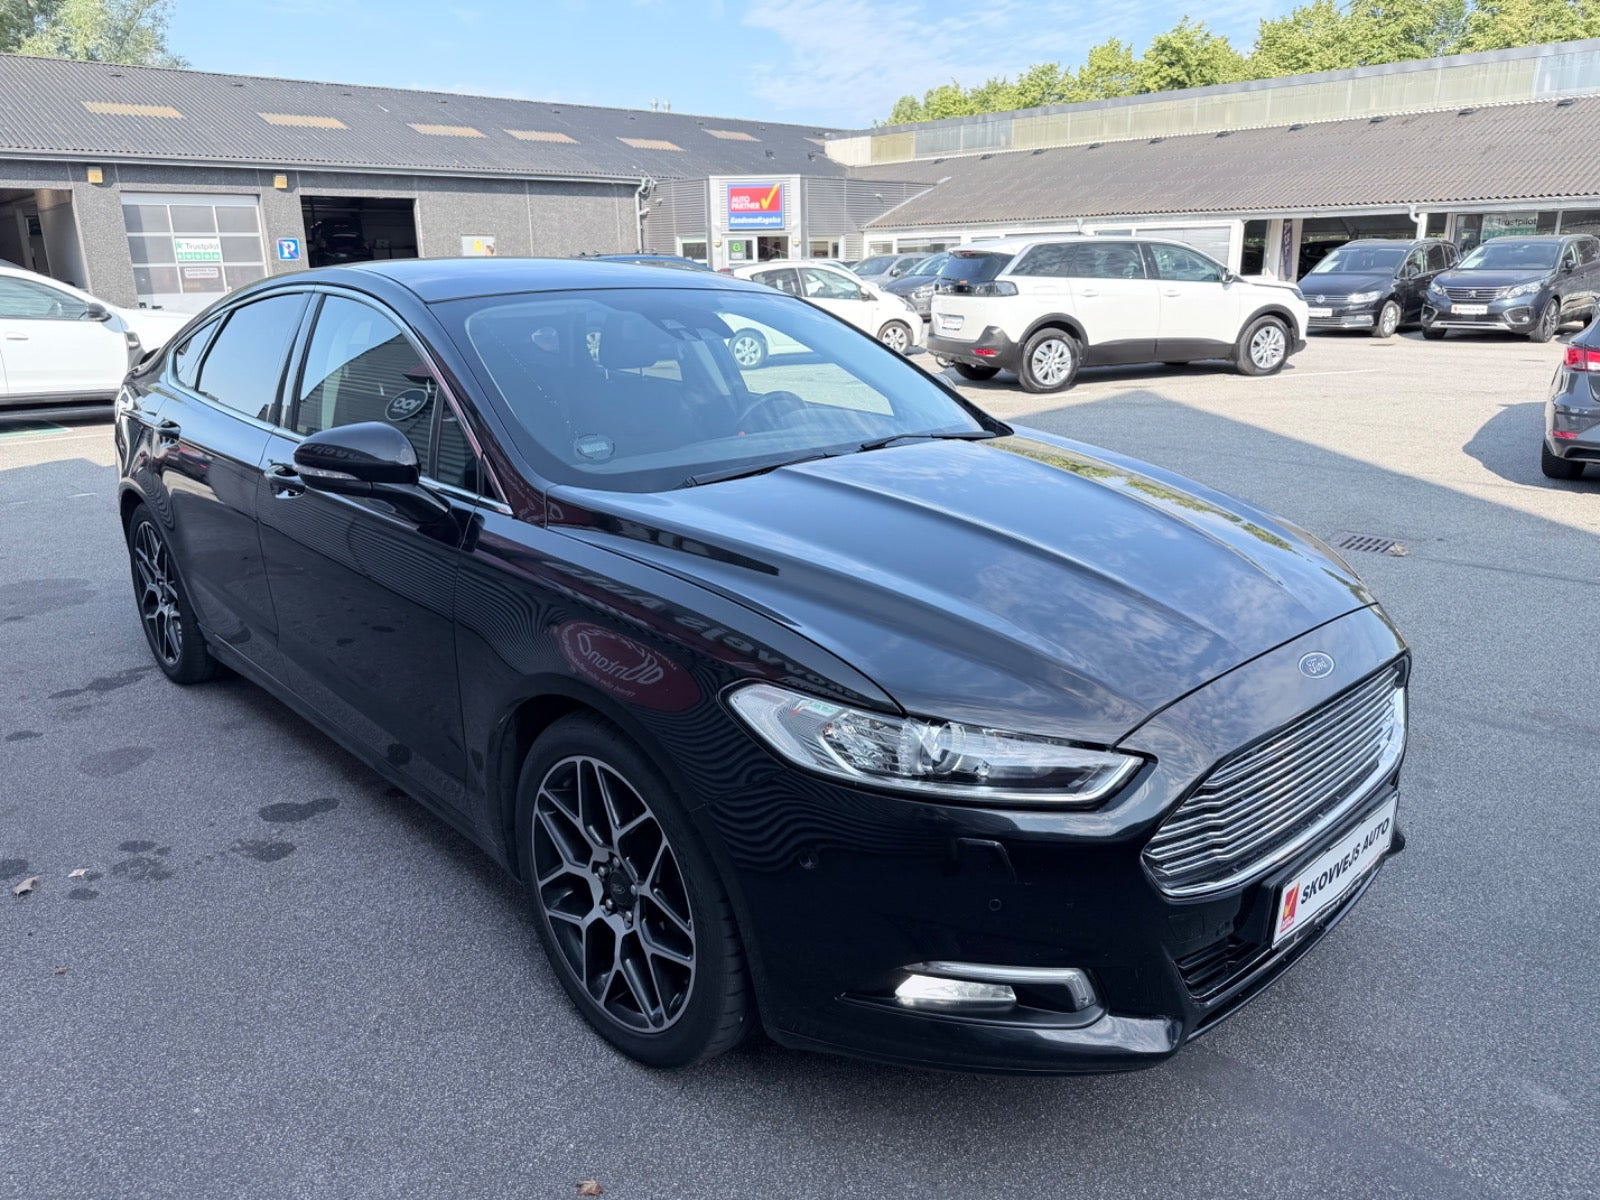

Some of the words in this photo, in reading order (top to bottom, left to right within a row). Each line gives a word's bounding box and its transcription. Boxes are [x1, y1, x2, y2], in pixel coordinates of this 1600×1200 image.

[731, 202, 760, 210] PARTNER
[185, 242, 219, 250] Trustpilot
[1300, 841, 1361, 905] SKOVVEJS
[1361, 816, 1390, 854] AUTO
